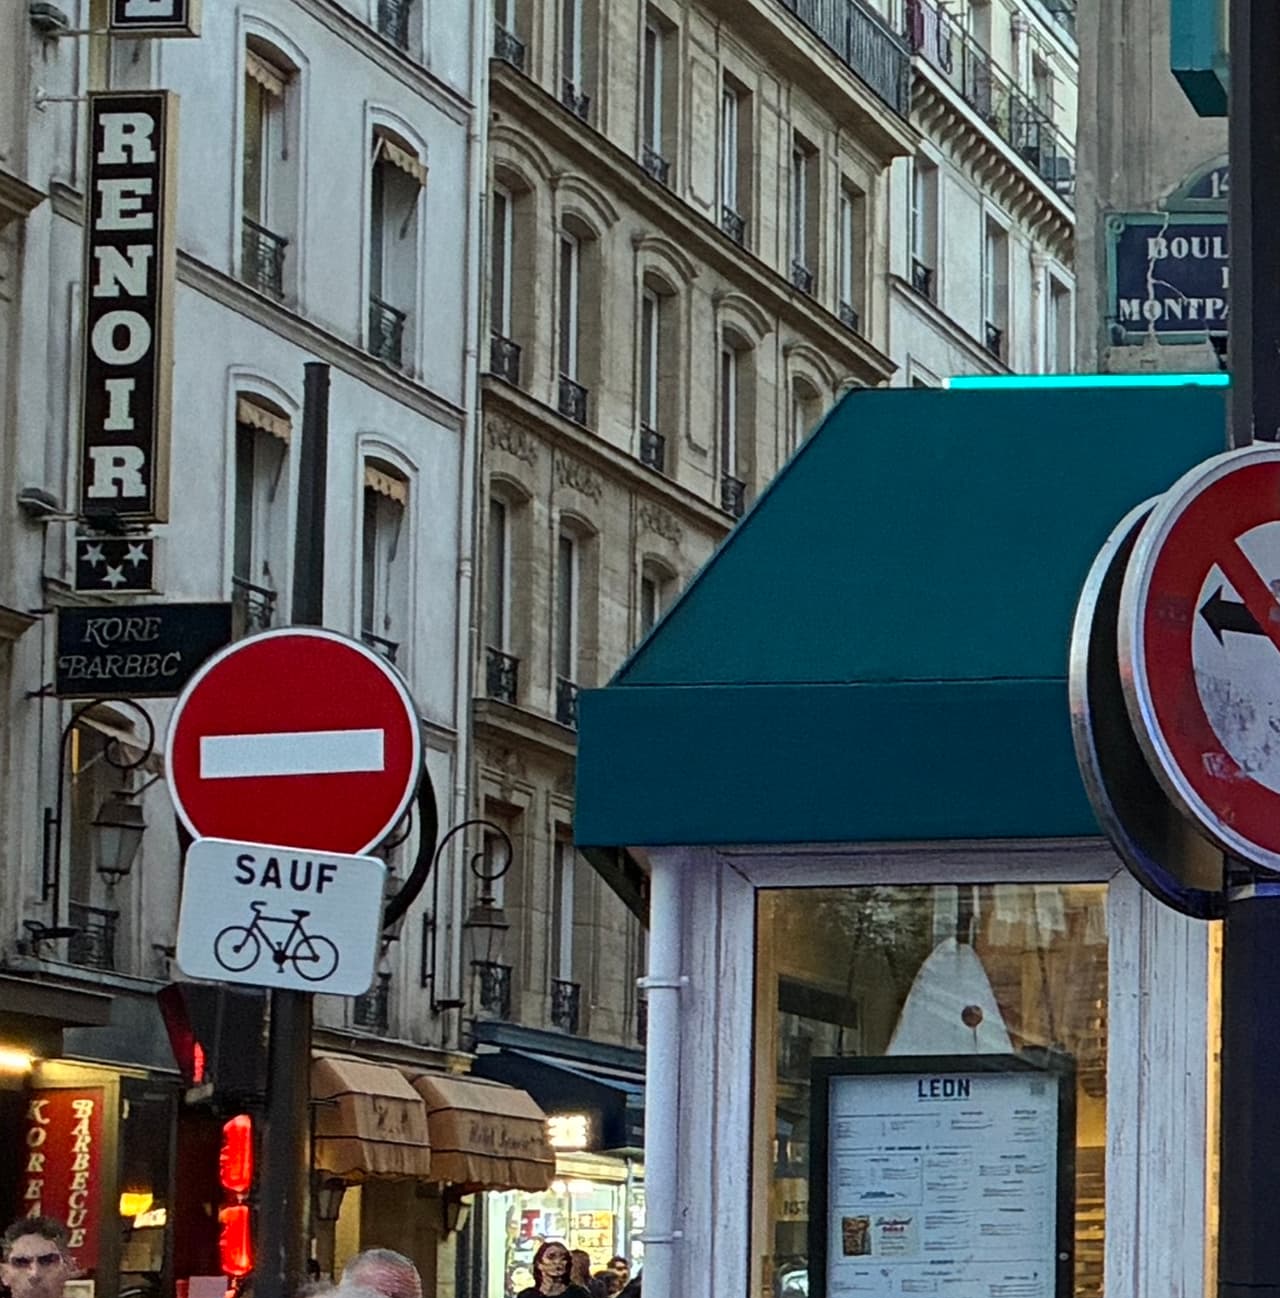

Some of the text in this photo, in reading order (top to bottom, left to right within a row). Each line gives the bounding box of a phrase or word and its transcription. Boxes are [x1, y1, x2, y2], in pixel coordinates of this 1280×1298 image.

[88, 112, 157, 499] RENOIR
[82, 616, 163, 648] KORE
[234, 853, 338, 893] SAUF
[67, 1100, 94, 1248] BARBECUE
